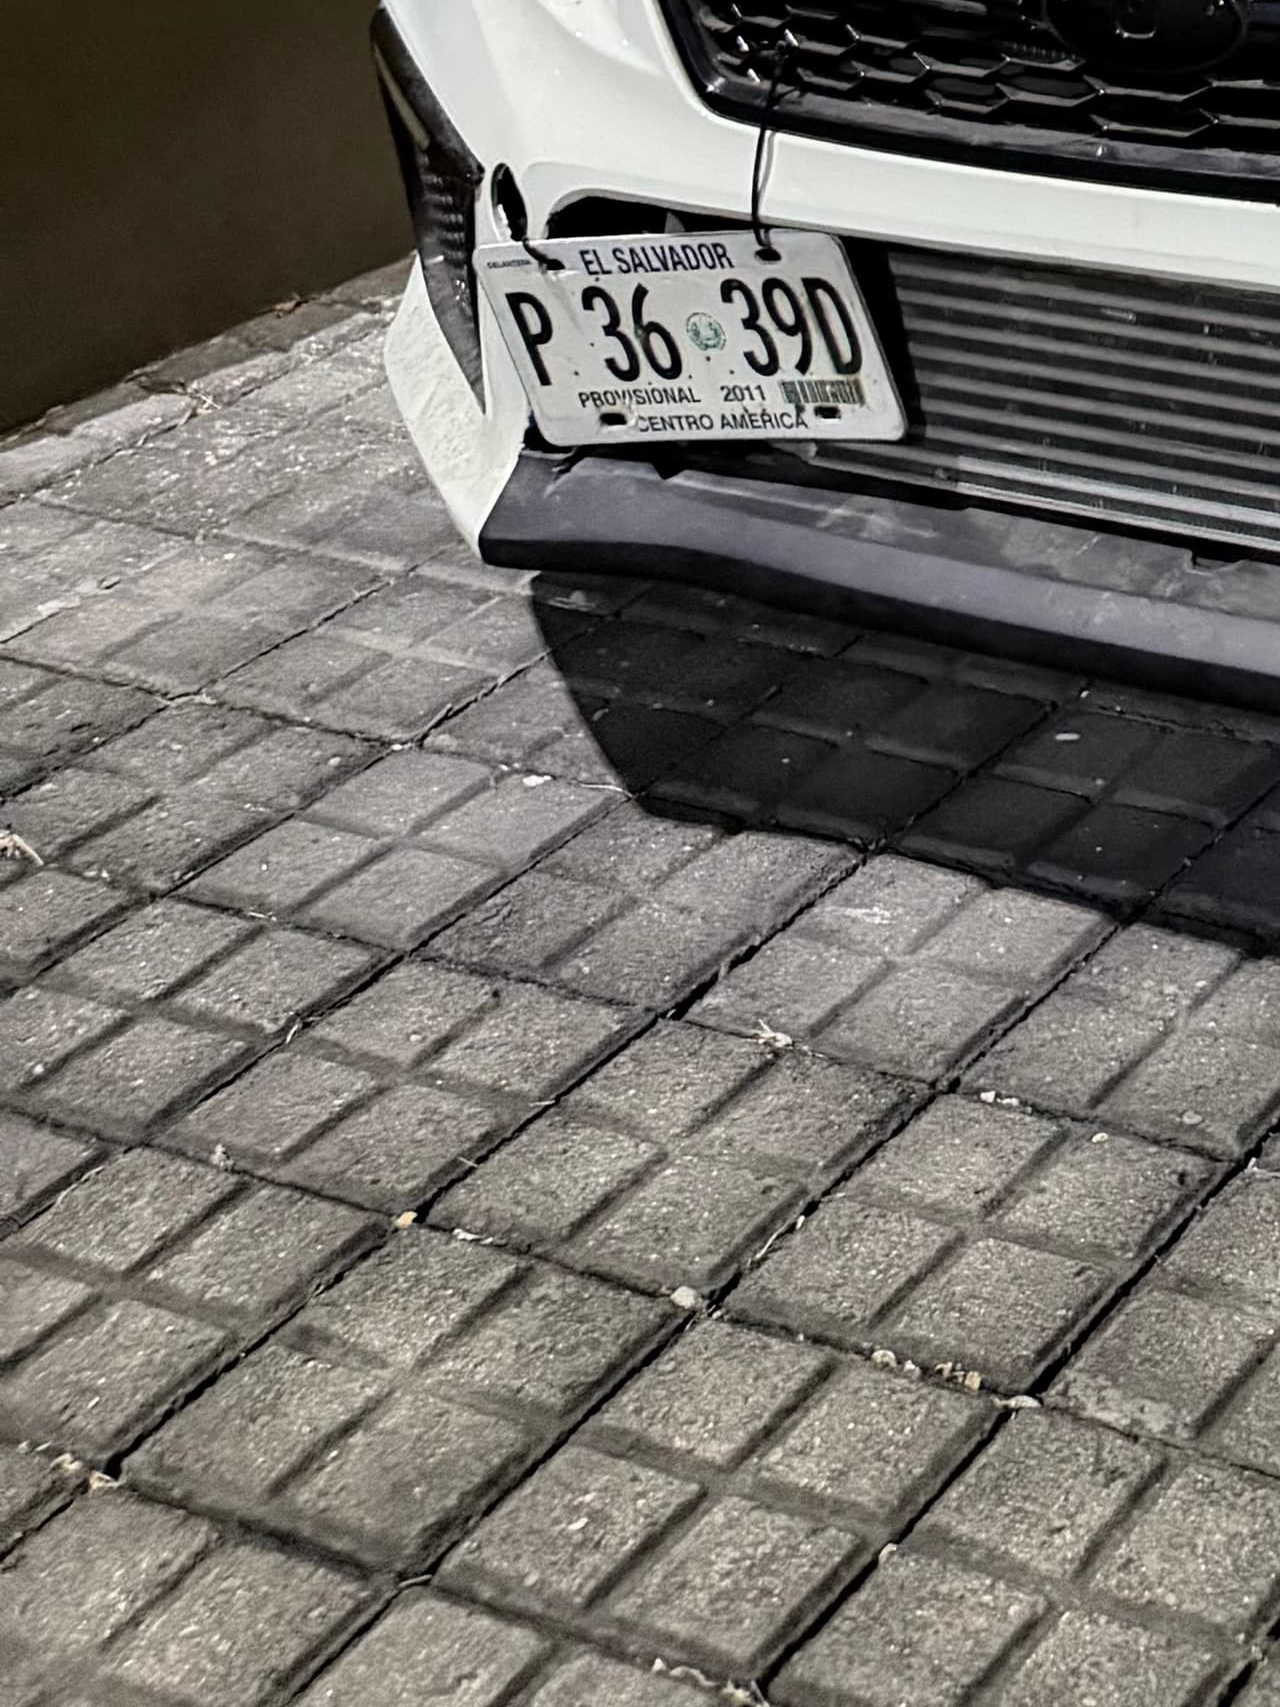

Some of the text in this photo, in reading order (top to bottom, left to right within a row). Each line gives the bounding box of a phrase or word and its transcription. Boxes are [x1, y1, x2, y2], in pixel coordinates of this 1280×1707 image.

[579, 242, 735, 276] EL SALVADOR
[504, 291, 553, 387] P
[581, 282, 683, 383] 36
[578, 383, 766, 409] PROVISIONAL 2011
[637, 413, 714, 433] CENTRO
